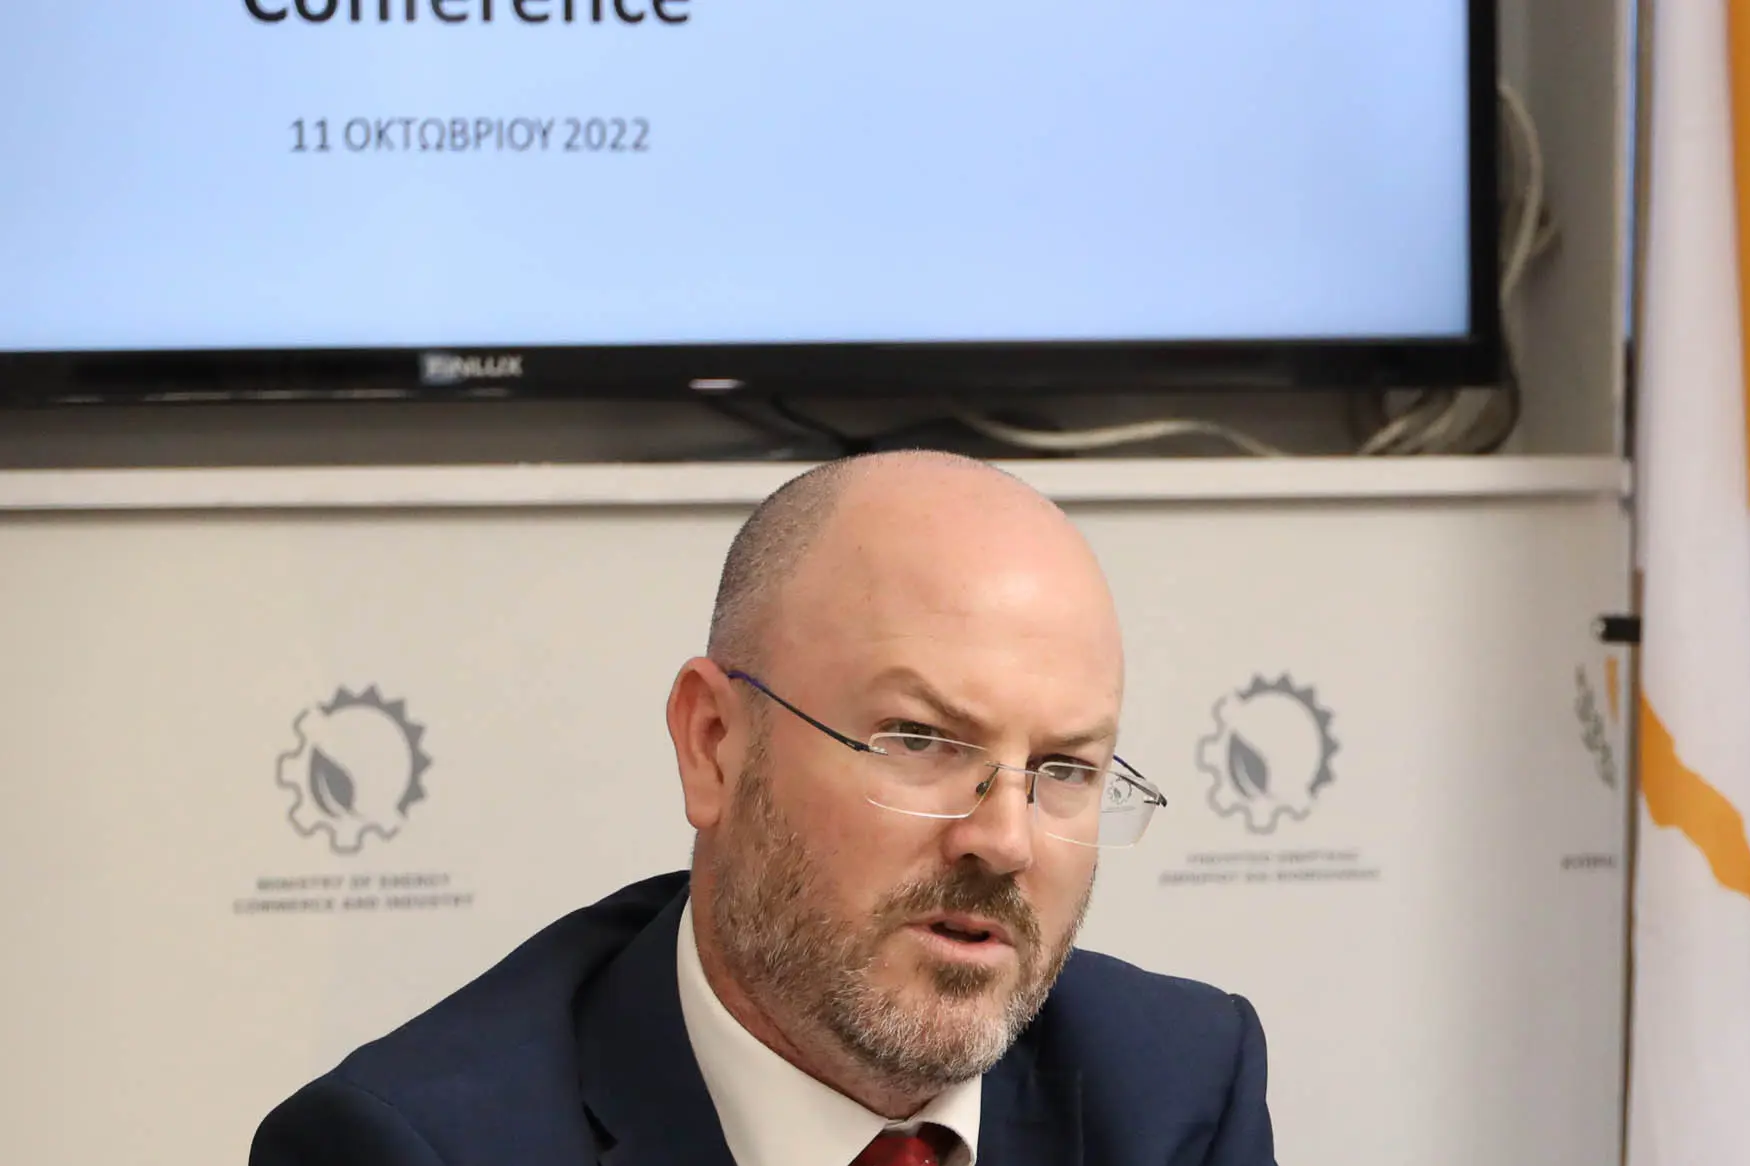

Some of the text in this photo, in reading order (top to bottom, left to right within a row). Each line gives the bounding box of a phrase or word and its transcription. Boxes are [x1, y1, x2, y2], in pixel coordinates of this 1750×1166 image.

[290, 116, 650, 152] 11 ΟΚΤΩΒΡΙΟΥ 2022
